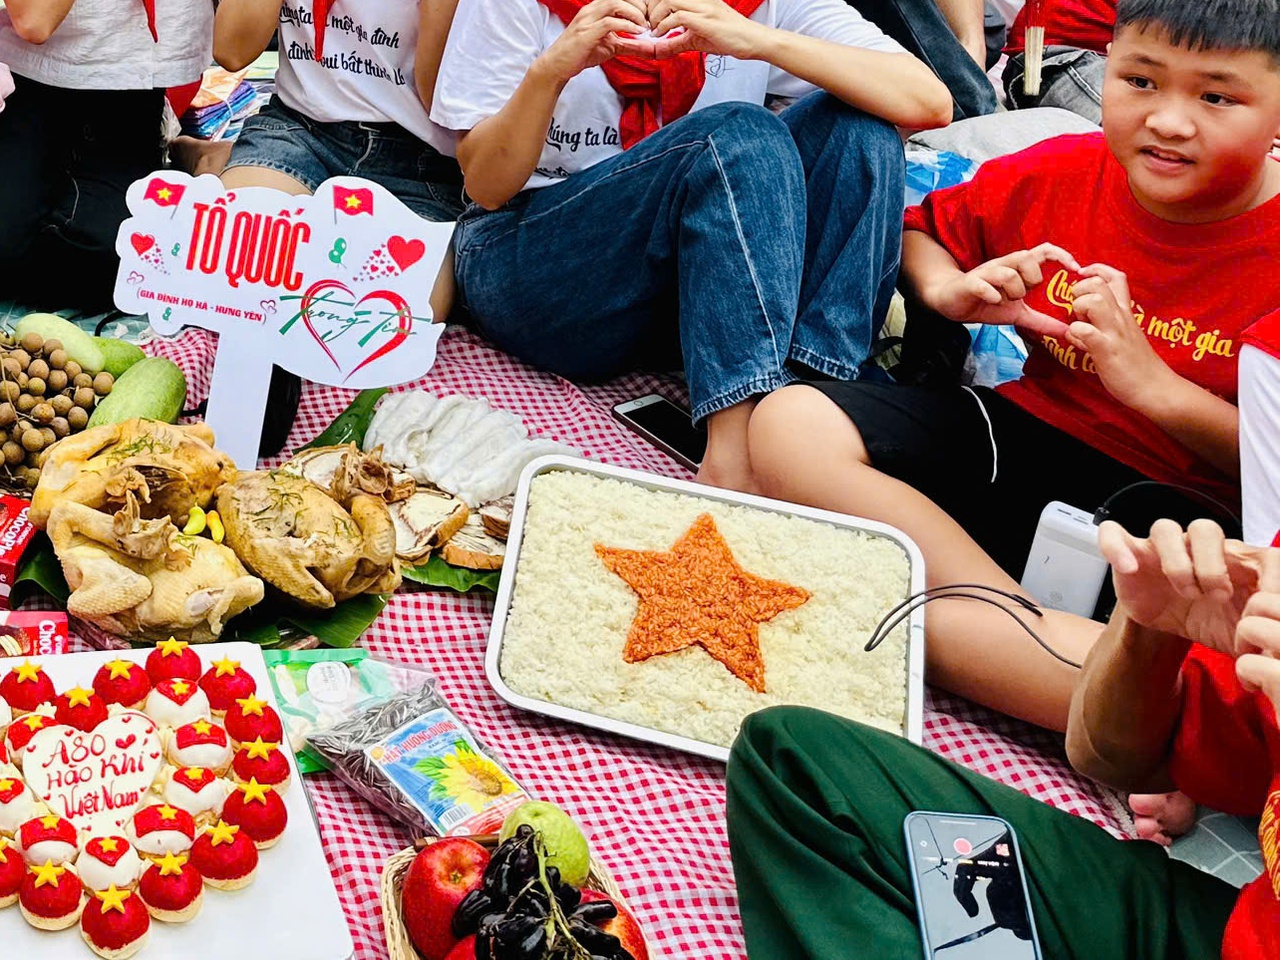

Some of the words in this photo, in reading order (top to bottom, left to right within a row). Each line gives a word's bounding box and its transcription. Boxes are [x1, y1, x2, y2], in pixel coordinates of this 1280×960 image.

[298, 6, 314, 24] ta
[331, 15, 356, 35] một
[370, 27, 400, 49] đình
[287, 40, 314, 61] đình
[340, 50, 363, 74] bất
[584, 126, 601, 146] ta
[602, 125, 620, 146] là
[185, 191, 237, 275] TỔ
[225, 208, 312, 292] QUỐC
[156, 292, 180, 305] ĐÌNH
[181, 297, 194, 309] HỌ
[195, 300, 208, 311] HÀ
[214, 304, 242, 318] HƯNG
[1147, 316, 1198, 349] một
[1191, 328, 1235, 362] gia
[42, 734, 107, 769] A80
[58, 784, 100, 820] Việt
[100, 779, 140, 811] Nam
